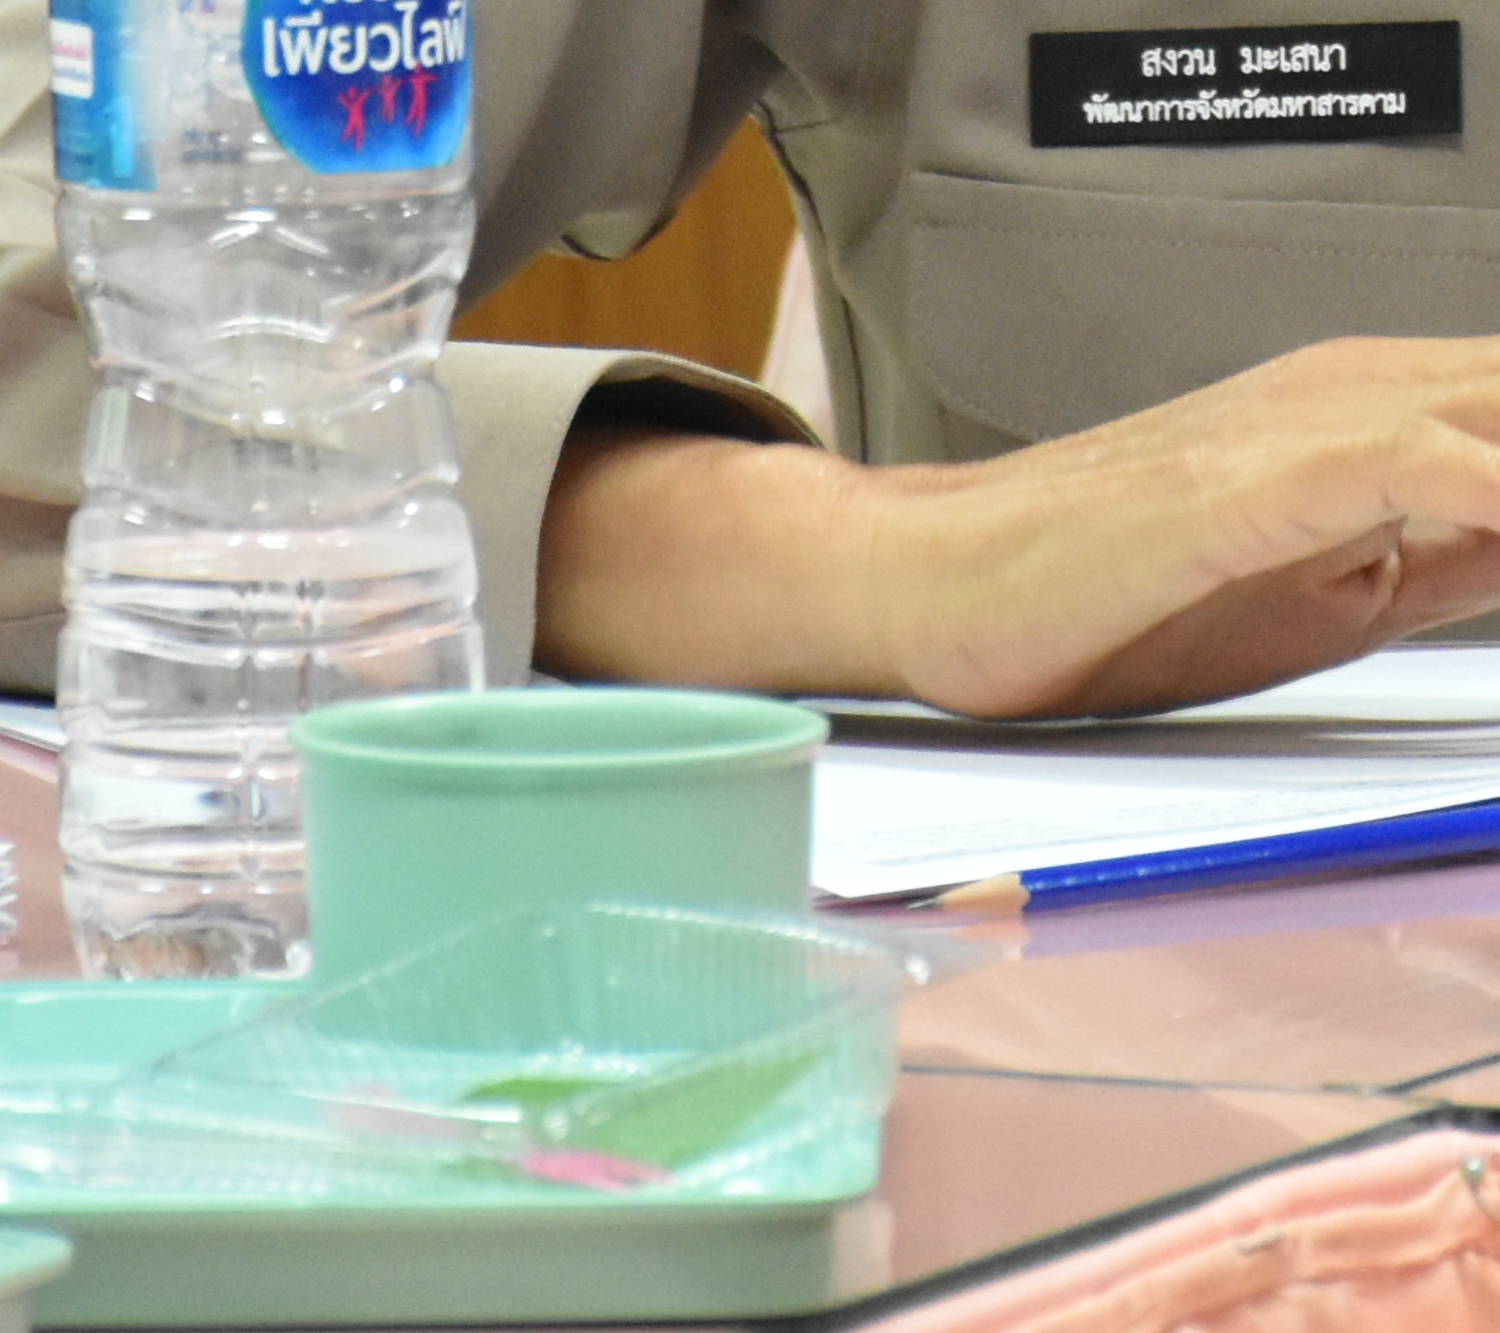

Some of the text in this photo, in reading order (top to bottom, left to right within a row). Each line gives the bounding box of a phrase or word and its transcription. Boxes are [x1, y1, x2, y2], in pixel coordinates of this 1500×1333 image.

[1141, 43, 1346, 77] สงวน มะเสนา
